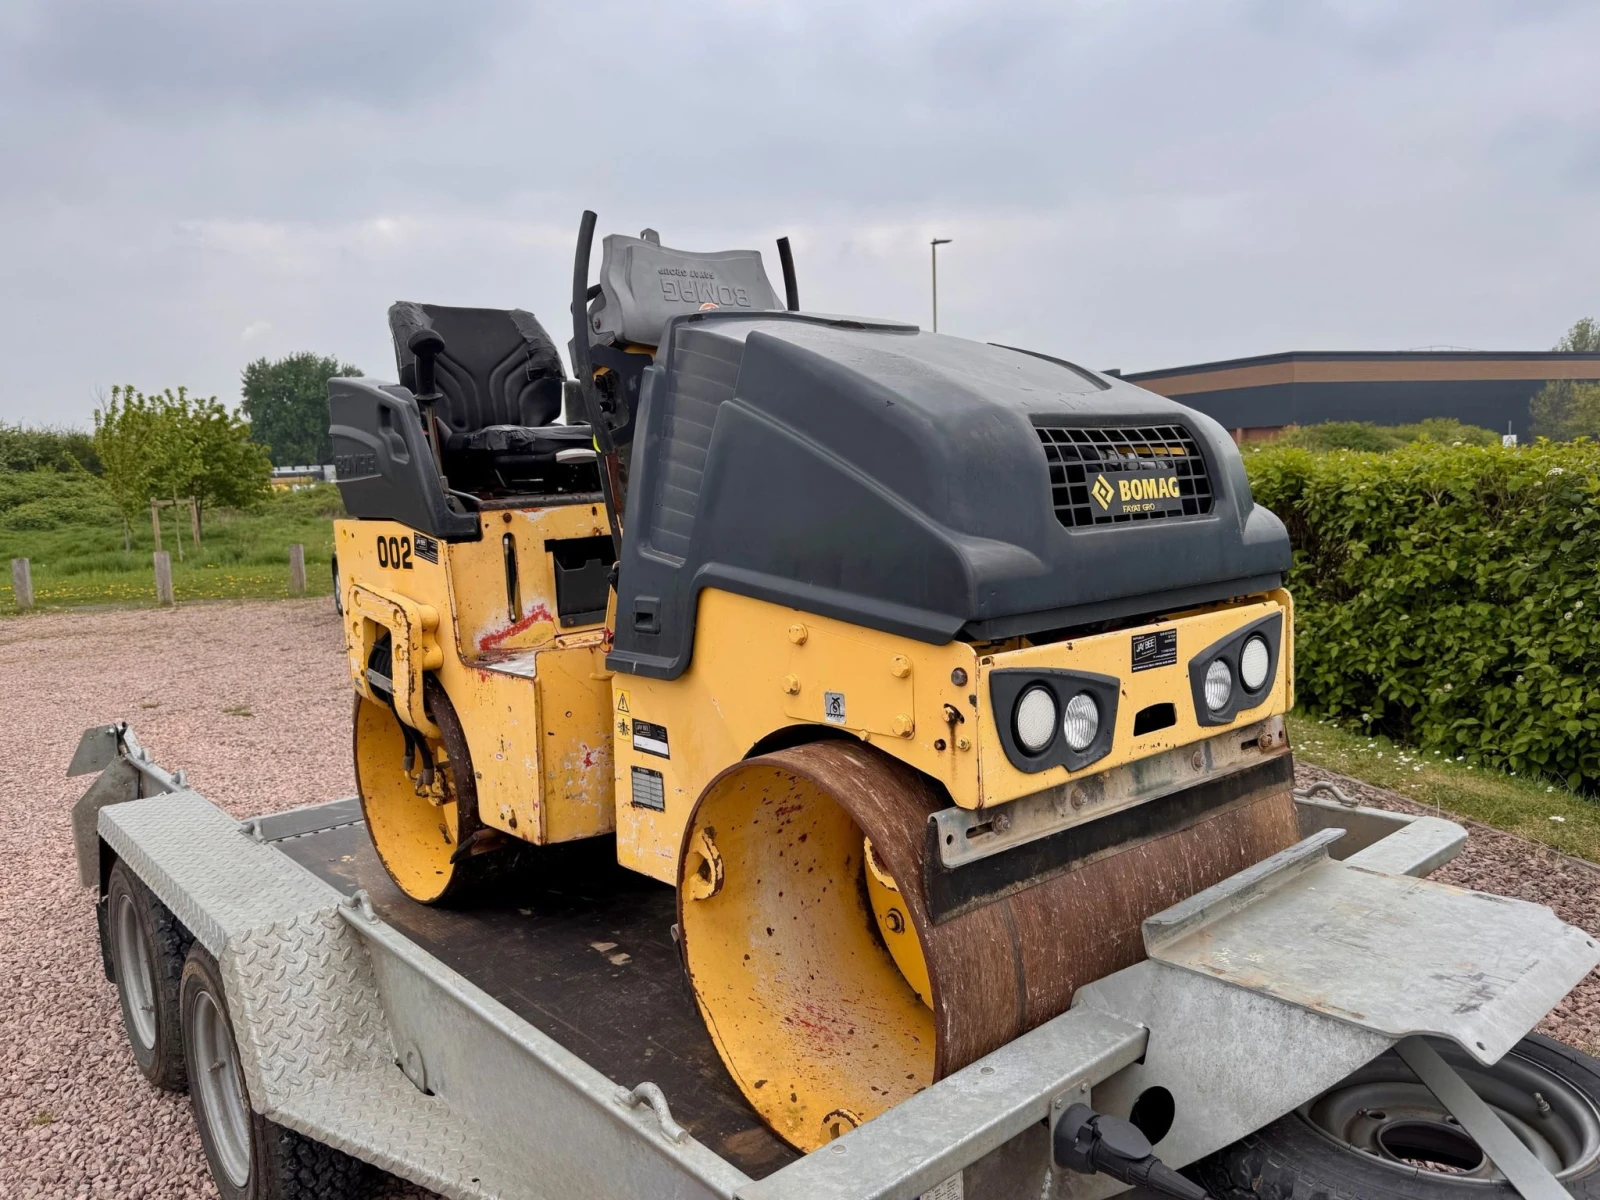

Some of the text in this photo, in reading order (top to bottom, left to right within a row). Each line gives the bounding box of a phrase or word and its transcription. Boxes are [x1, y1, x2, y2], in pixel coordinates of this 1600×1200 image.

[658, 267, 688, 277] GROUP
[660, 279, 751, 307] BOMAG
[1118, 476, 1180, 502] BOMAG
[1122, 504, 1141, 513] FAYAT
[377, 535, 414, 570] 002
